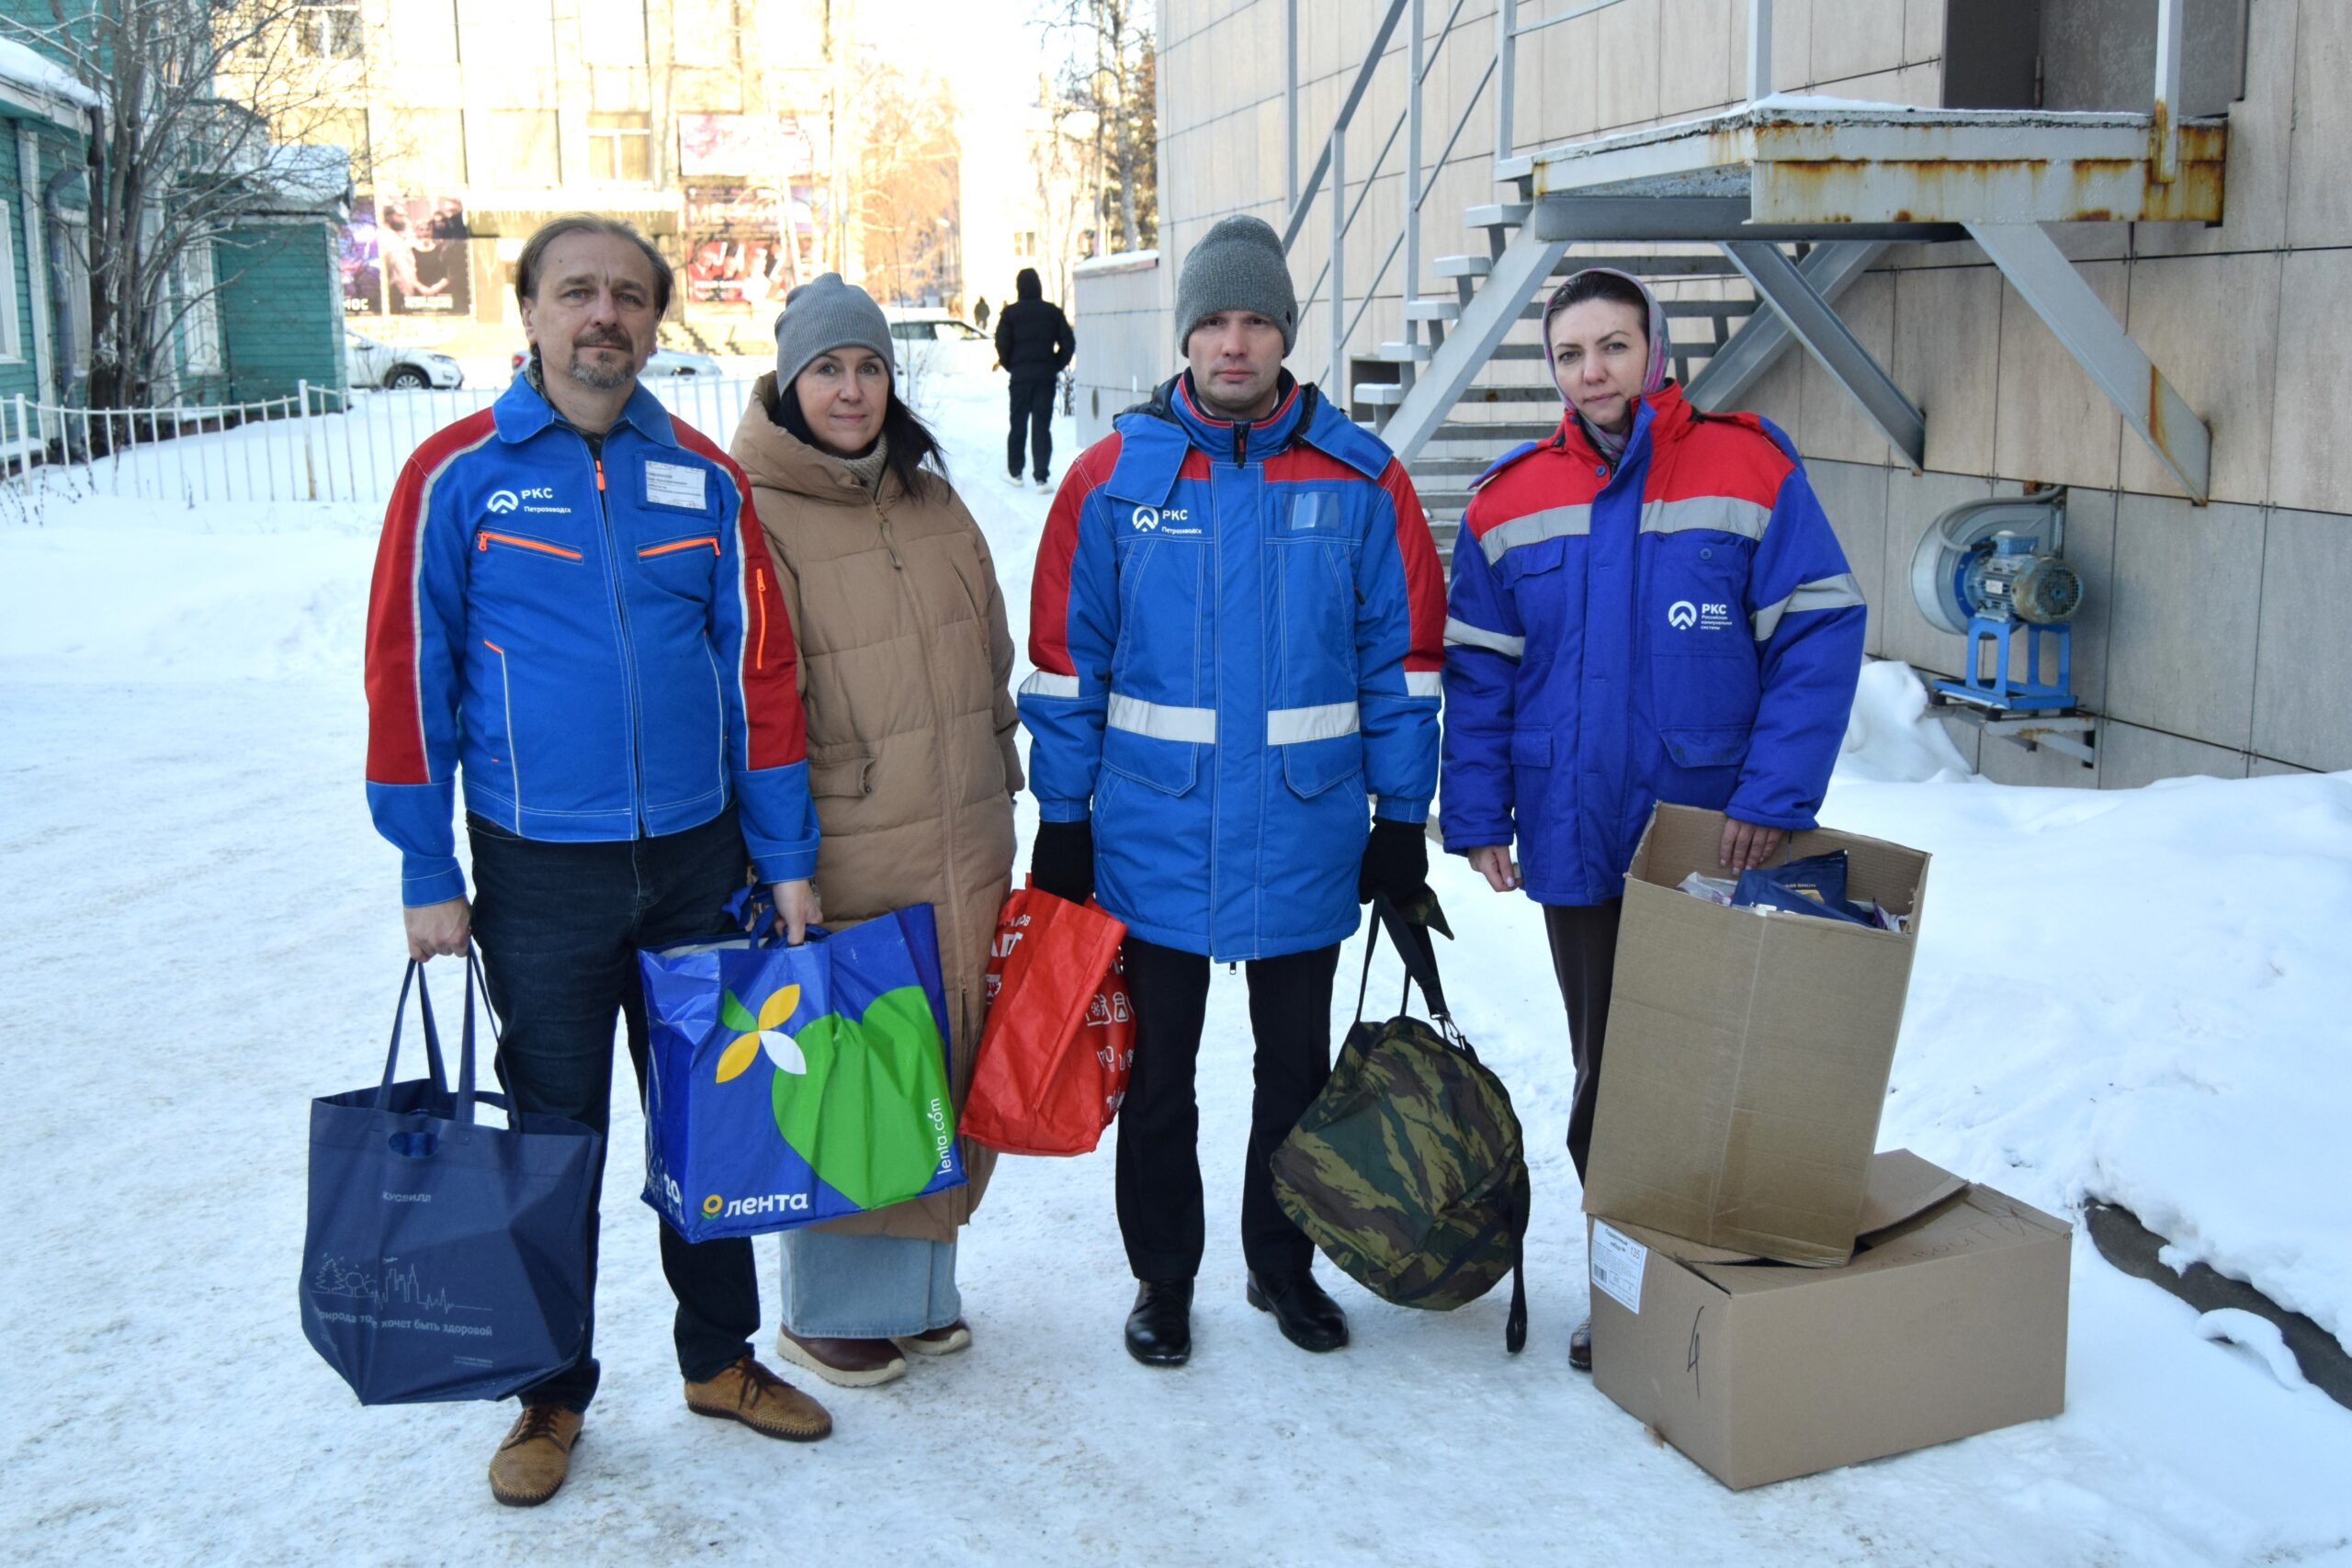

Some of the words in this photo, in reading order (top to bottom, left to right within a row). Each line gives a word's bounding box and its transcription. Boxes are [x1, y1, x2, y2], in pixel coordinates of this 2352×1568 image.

[521, 487, 553, 500] РКС
[524, 505, 572, 513] Петрозаводск
[1162, 509, 1188, 521] РКС
[1702, 603, 1727, 615] РКС
[930, 1098, 953, 1175] lenta.com
[724, 1193, 808, 1218] лента
[1630, 1246, 1642, 1260] 135
[381, 1318, 412, 1329] хочет
[414, 1318, 441, 1331] быть
[442, 1323, 493, 1337] здоровой
